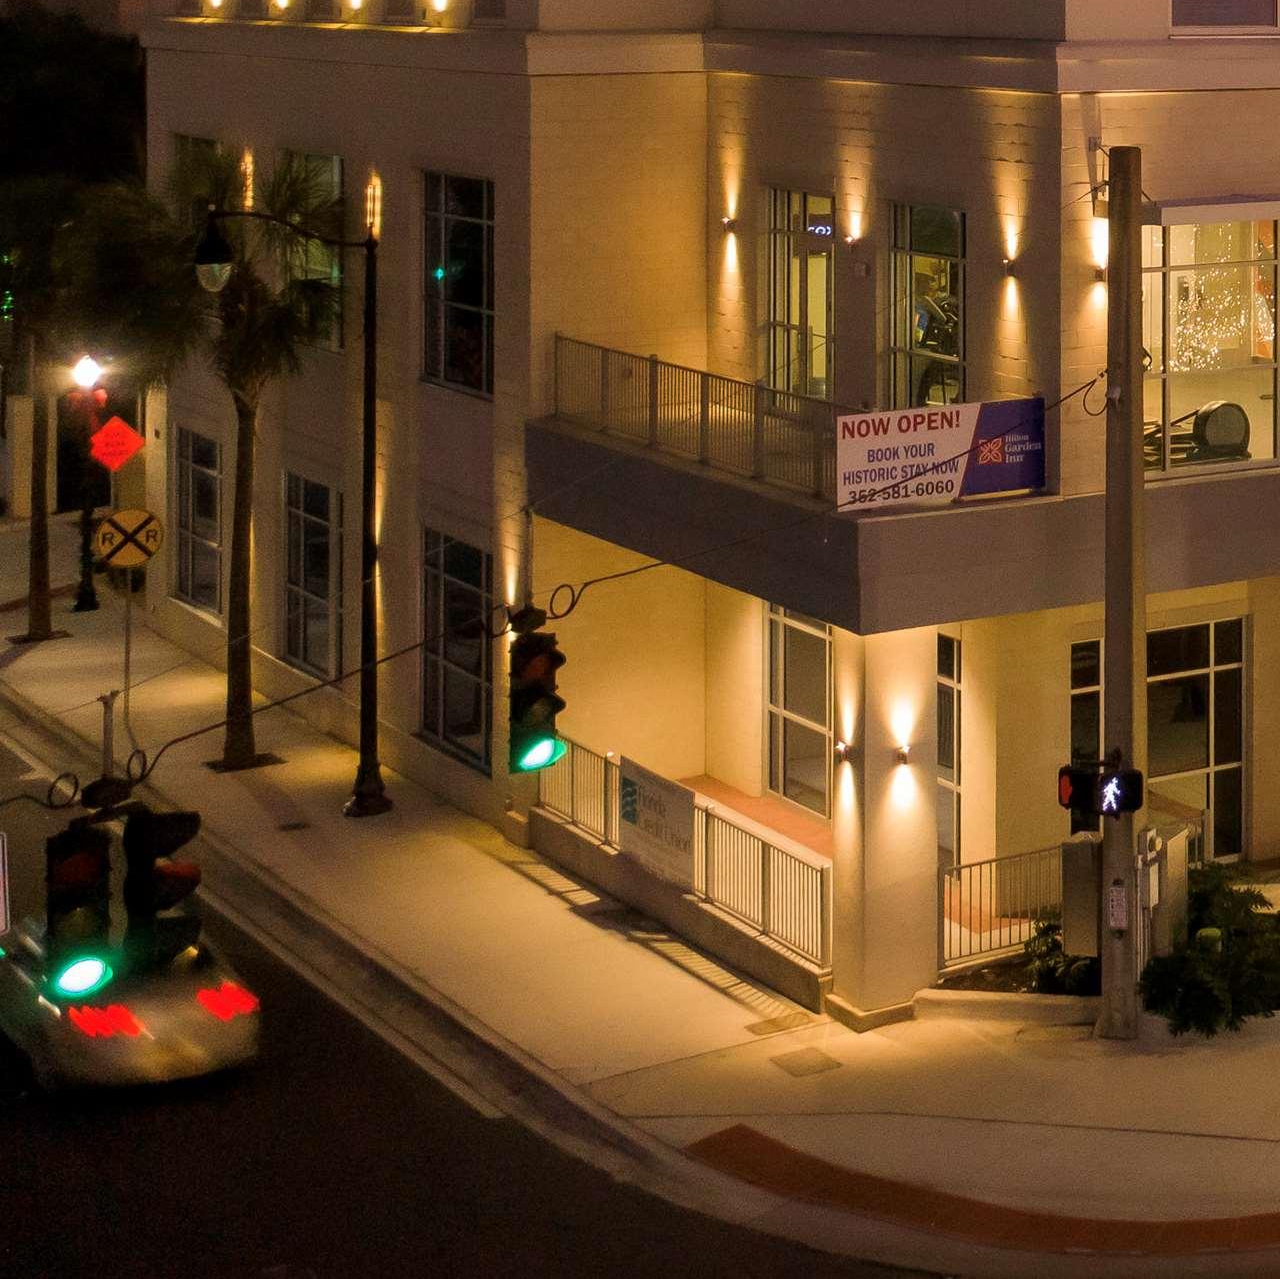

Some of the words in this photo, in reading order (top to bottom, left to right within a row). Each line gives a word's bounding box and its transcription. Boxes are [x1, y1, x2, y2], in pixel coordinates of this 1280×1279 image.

[842, 417, 890, 439] NOW
[897, 410, 960, 433] OPEN!
[868, 447, 899, 463] BOOK
[903, 443, 935, 459] YOUR
[1005, 441, 1041, 453] Garden
[1005, 453, 1025, 463] Inn
[843, 466, 897, 486] HISTORIC
[901, 463, 929, 479] STAY
[932, 459, 959, 475] NOW
